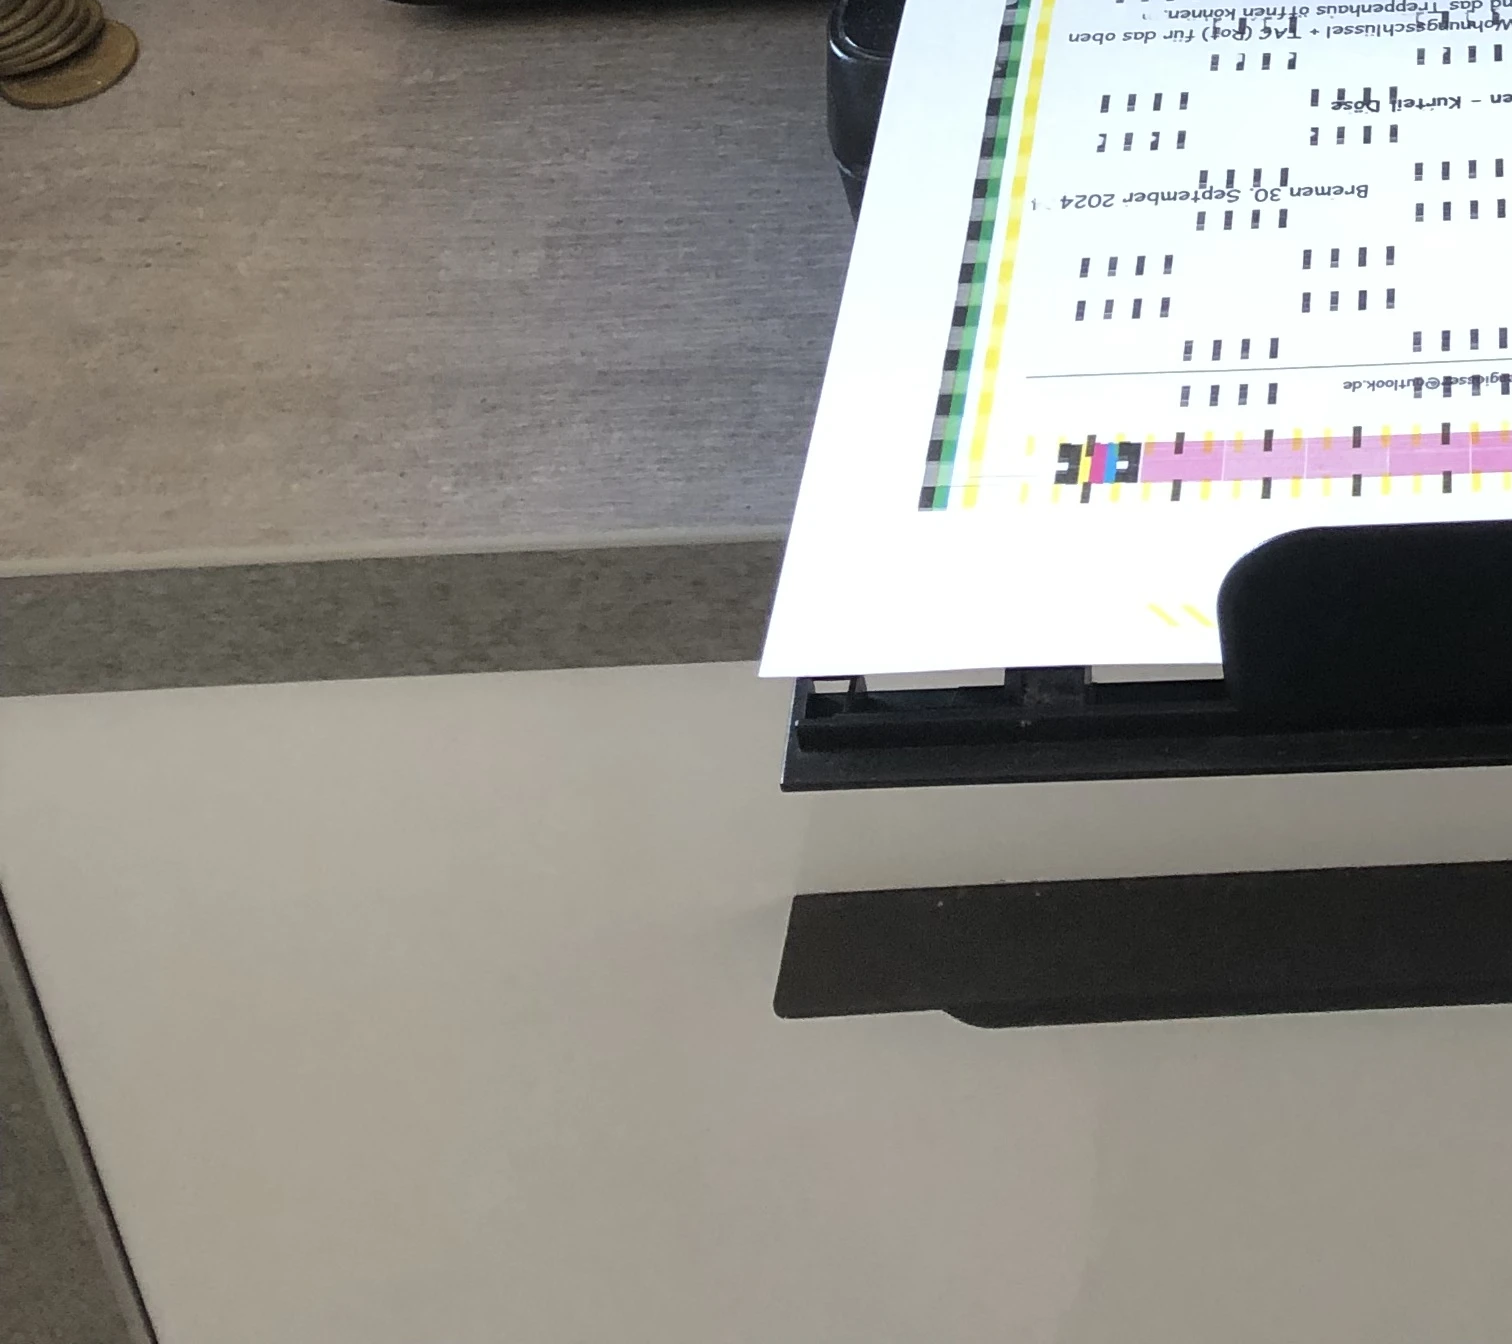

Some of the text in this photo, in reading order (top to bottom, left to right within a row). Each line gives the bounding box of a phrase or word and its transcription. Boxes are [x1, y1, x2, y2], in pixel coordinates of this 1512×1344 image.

[1163, 7, 1236, 22] können.
[1243, 5, 1310, 20] öffnen
[1316, 1, 1439, 18] Treppenhaus
[1450, 0, 1483, 14] das
[1068, 32, 1116, 45] oben
[1122, 31, 1156, 44] das
[1163, 29, 1195, 44] für
[1201, 27, 1252, 42] (Rot)
[1259, 26, 1302, 40] TAC
[1331, 100, 1380, 114] Döse
[1391, 96, 1461, 112] Kurteil
[1060, 184, 1368, 209] Bremen 30. September 2024
